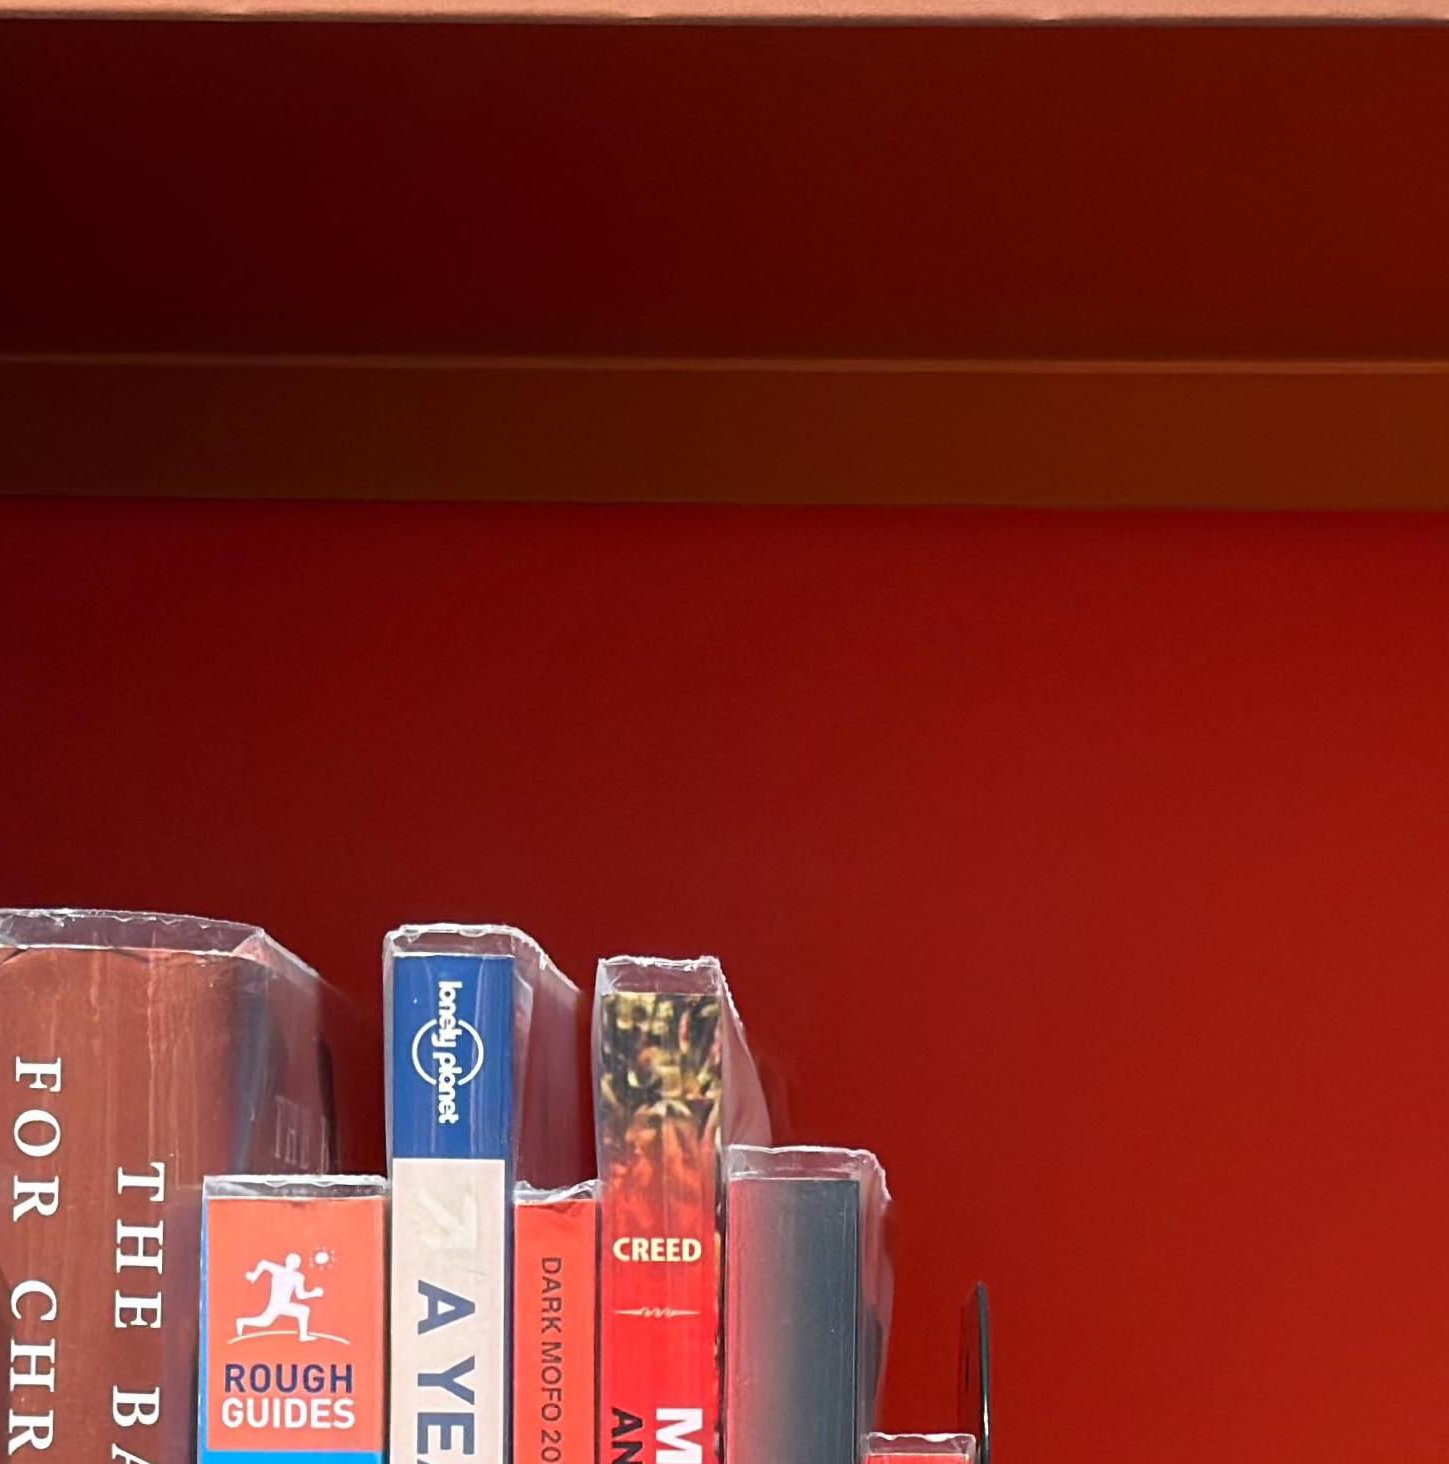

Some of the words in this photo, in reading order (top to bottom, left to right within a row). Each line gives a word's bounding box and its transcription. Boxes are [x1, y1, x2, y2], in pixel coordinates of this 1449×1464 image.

[431, 980, 464, 1048] lonely
[433, 1049, 461, 1124] planet
[12, 1056, 63, 1222] FOR
[114, 1162, 165, 1329] THE
[613, 1237, 702, 1263] CREED
[416, 1279, 476, 1335] A
[540, 1257, 562, 1335] DARK
[222, 1398, 355, 1430] GUIDES
[224, 1364, 352, 1394] ROUGH
[540, 1341, 562, 1424] MOFO
